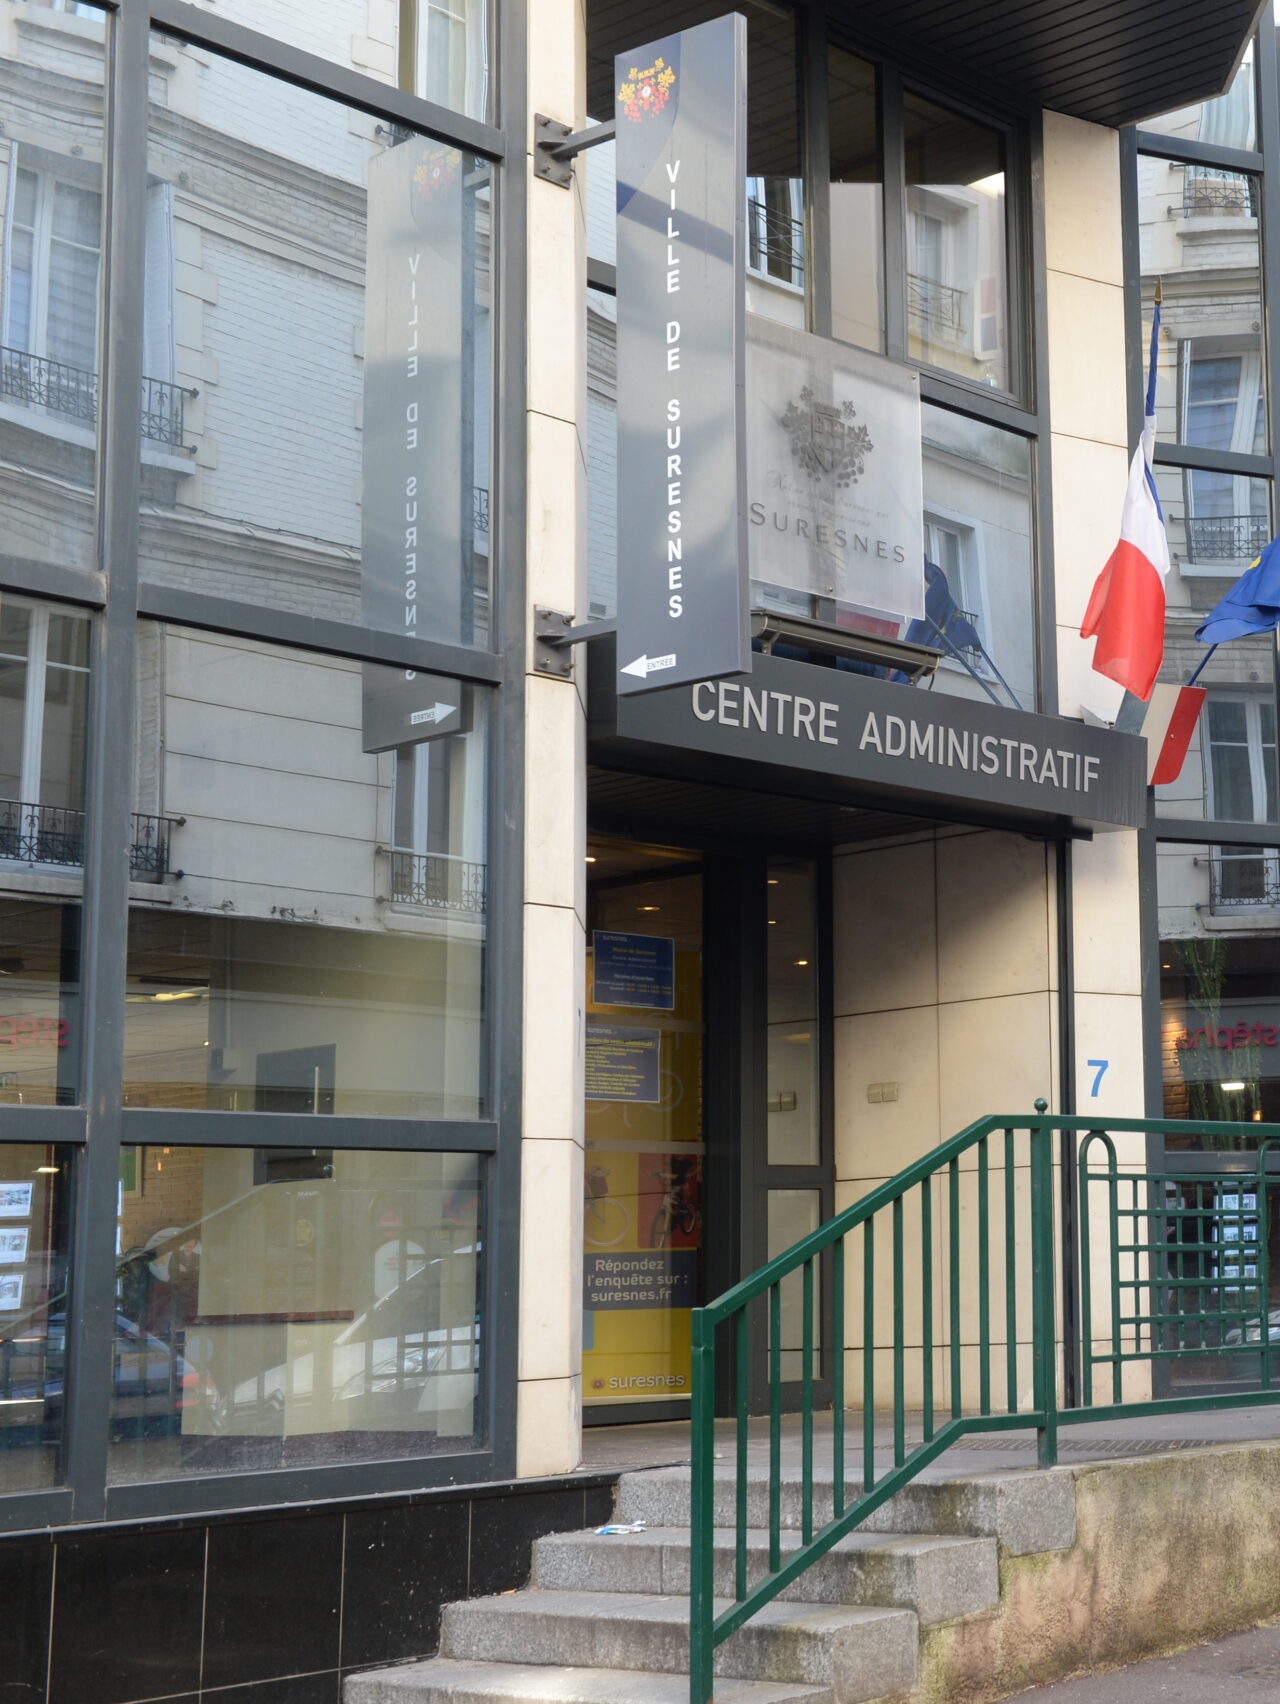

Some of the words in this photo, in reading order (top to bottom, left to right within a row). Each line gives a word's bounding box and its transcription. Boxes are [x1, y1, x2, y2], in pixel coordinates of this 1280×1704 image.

[666, 160, 680, 293] VILLE
[666, 320, 681, 372] DE
[667, 399, 683, 618] SURESNES
[750, 502, 905, 563] SURESNES
[646, 658, 674, 670] ENTREE
[691, 680, 840, 745] CENTRE
[858, 711, 1101, 793] ADMINISTRATIF
[1087, 1059, 1108, 1097] 7
[587, 1274, 653, 1289] l'enquête
[656, 1274, 680, 1285] sur
[595, 1259, 664, 1273] Répondez
[591, 1288, 672, 1302] suresnes.fr
[608, 1374, 685, 1389] suresnes
